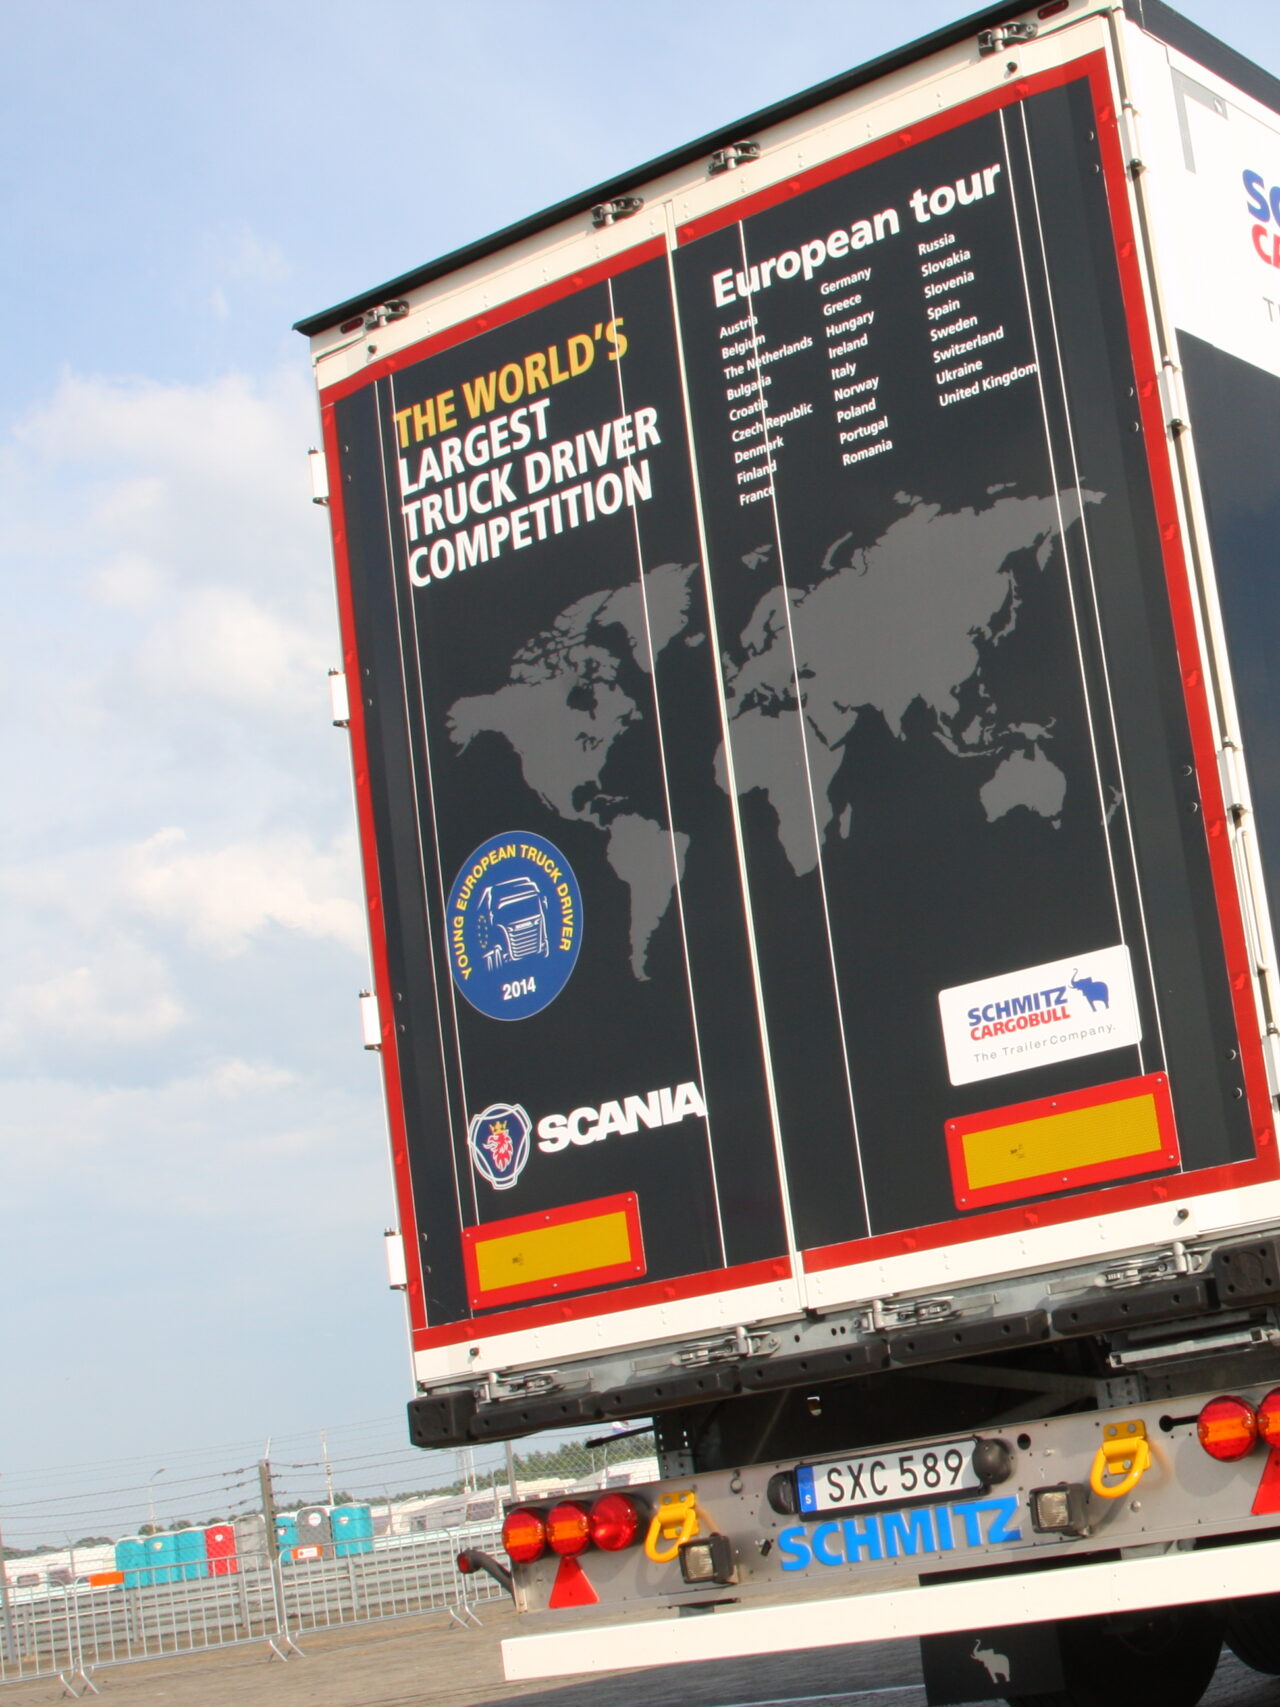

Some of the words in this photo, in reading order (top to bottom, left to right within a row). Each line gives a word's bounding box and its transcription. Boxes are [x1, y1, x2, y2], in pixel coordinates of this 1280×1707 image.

[712, 207, 900, 308] European
[910, 163, 1000, 223] tour
[918, 233, 955, 255] Russia
[921, 249, 971, 276] Slovakia
[821, 268, 871, 295] Germany
[924, 270, 974, 298] Slovenia
[823, 293, 861, 316] Greece
[927, 298, 960, 320] Spain
[720, 314, 758, 339] Austria
[826, 311, 874, 338] Hungary
[930, 315, 978, 341] Sweden
[722, 334, 765, 360] Belgium
[724, 365, 744, 380] The
[747, 336, 813, 371] Netherlands
[829, 334, 868, 359] Ireland
[933, 327, 1004, 363] Switzerland
[393, 390, 458, 447] THE
[463, 318, 628, 419] WORLD'S
[832, 362, 856, 380] Italy
[936, 360, 983, 384] Ukraine
[939, 383, 979, 407] United
[983, 362, 1038, 392] Kingdom
[727, 375, 772, 401] Bulgaria
[834, 377, 879, 401] Norway
[729, 399, 768, 421] Croatia
[732, 421, 763, 442] Czech
[767, 403, 813, 430] Republic
[837, 399, 876, 422] Poland
[840, 417, 888, 444] Portugal
[399, 398, 550, 497] LARGEST
[734, 436, 784, 464] Denmark
[843, 439, 893, 466] Romania
[401, 462, 517, 541] TRUCK
[525, 406, 661, 494] DRIVER
[737, 460, 776, 485] Finland
[740, 485, 774, 506] France
[410, 459, 652, 587] COMPETITION
[456, 844, 515, 911] EUROPEAN
[520, 845, 562, 884] TRUCK
[556, 883, 574, 951] DRIVER
[453, 916, 472, 980] YOUNG
[502, 977, 536, 1000] 2014
[968, 986, 1068, 1027] SCHMITZ
[970, 1006, 1071, 1041] CARGOBULL
[974, 1050, 997, 1063] The
[537, 1082, 708, 1153] SCANIA
[828, 1461, 887, 1502] SXC
[899, 1449, 962, 1491] 589
[806, 1495, 811, 1504] S
[777, 1495, 1022, 1571] SCHMITZ
